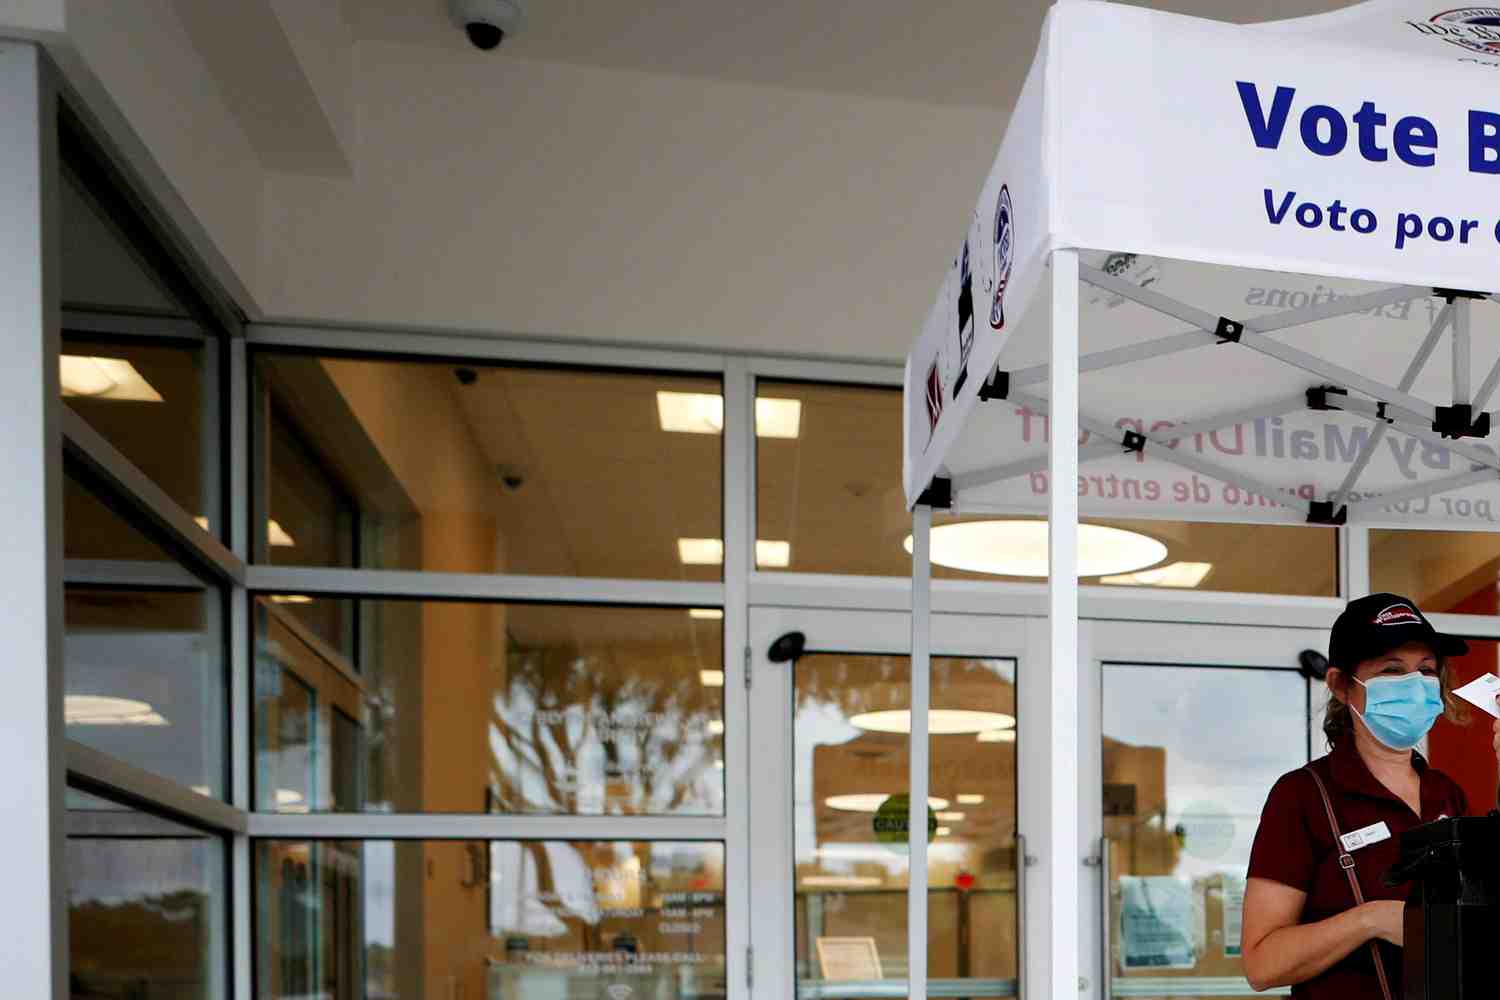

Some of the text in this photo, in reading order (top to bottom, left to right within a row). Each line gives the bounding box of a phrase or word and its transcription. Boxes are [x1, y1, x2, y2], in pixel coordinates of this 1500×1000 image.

[1236, 80, 1438, 168] Vote
[1263, 188, 1377, 234] Voto
[1395, 213, 1479, 250] por
